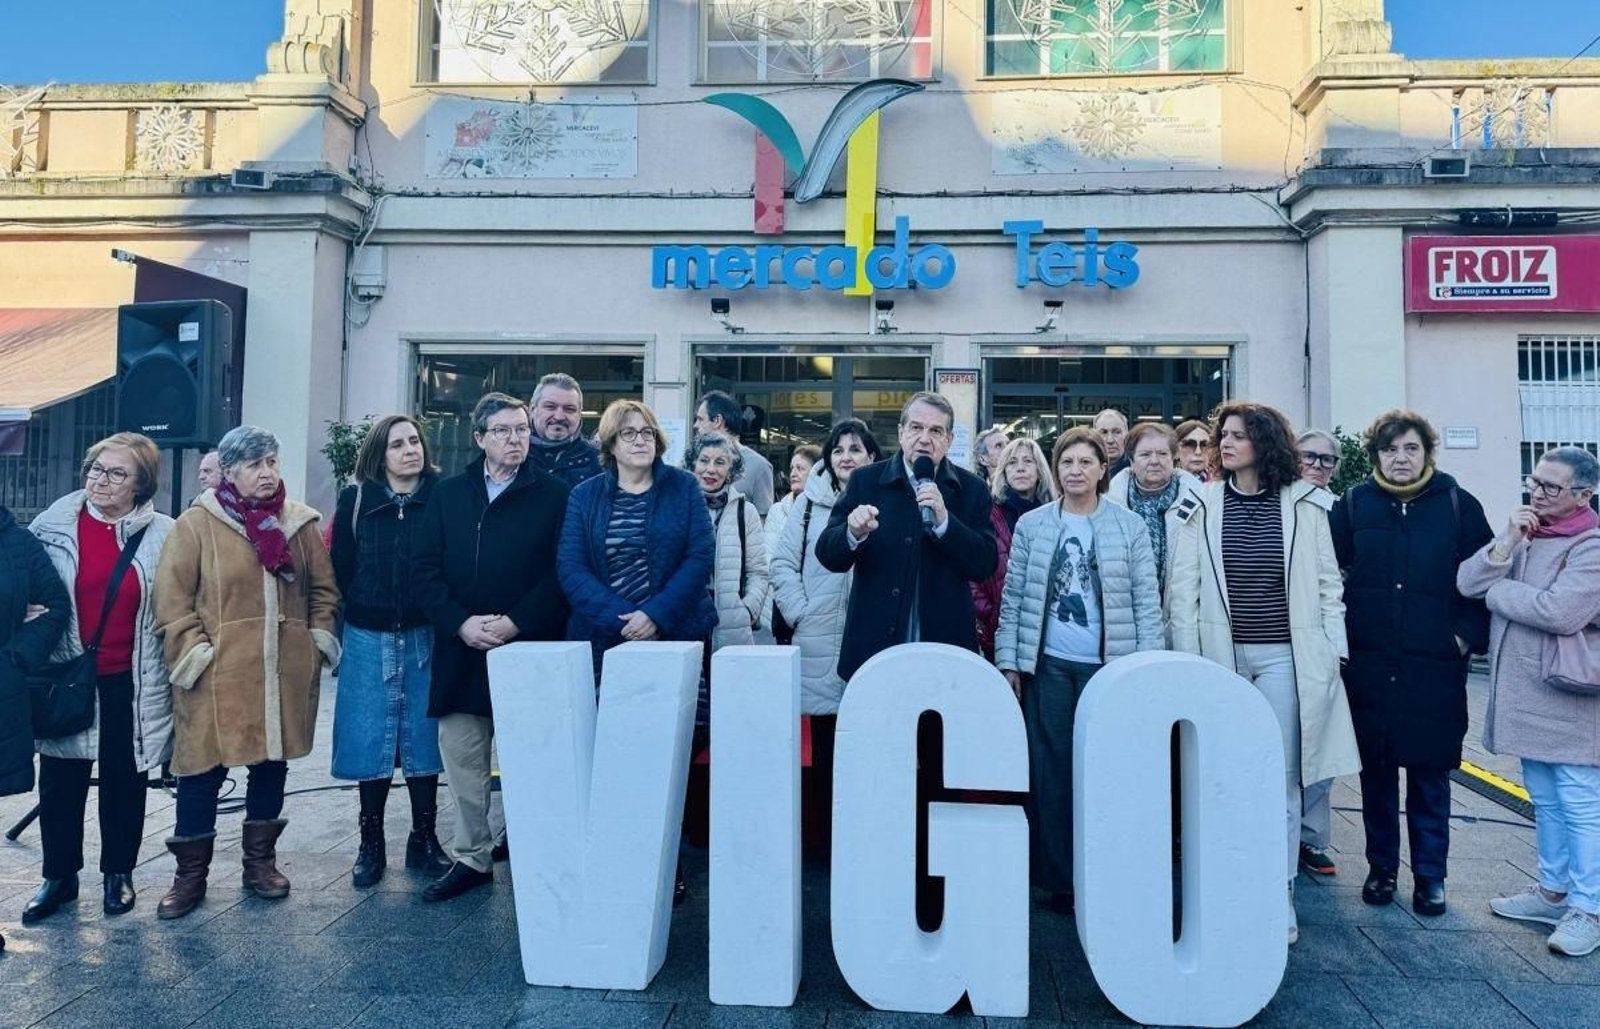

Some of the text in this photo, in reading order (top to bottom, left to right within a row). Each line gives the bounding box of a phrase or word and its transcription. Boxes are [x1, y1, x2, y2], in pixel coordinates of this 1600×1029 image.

[652, 215, 1140, 290] mercado Teis
[1435, 249, 1549, 284] FROIZ
[1454, 286, 1490, 296] Siempre
[1512, 287, 1549, 295] servicio
[939, 375, 976, 384] OFERTAS
[141, 423, 169, 431] WORK
[487, 640, 1288, 1027] VIGO
